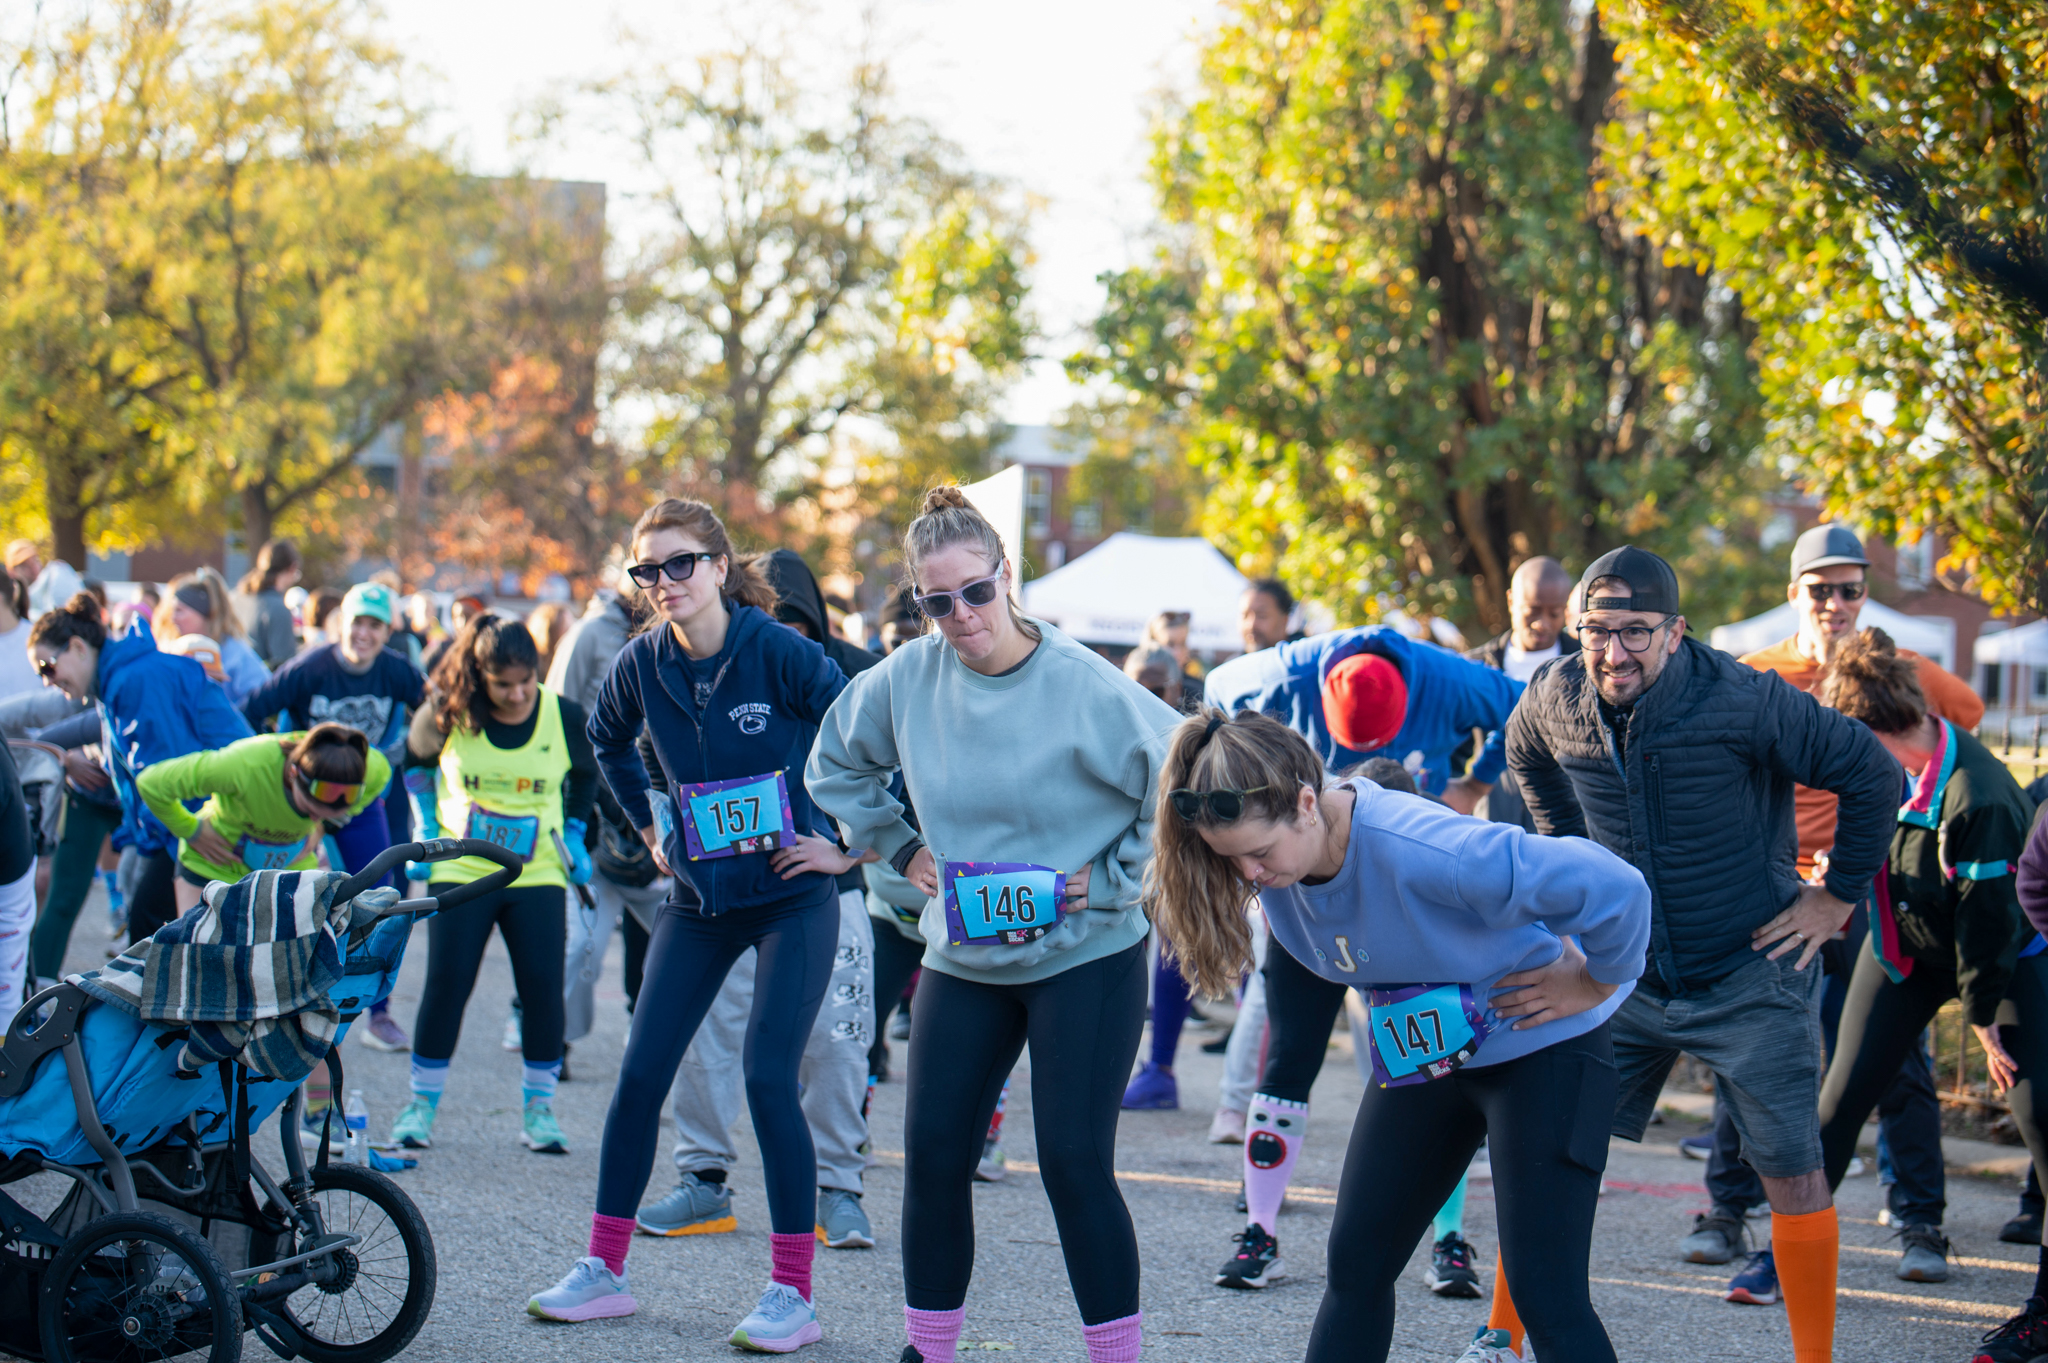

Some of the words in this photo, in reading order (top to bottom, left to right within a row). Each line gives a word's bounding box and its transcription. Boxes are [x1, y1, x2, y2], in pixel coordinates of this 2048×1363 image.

[728, 703, 750, 721] PENN
[749, 703, 771, 715] STATE
[708, 796, 760, 836] 157
[485, 823, 523, 850] 187
[975, 885, 1036, 924] 146
[1334, 935, 1357, 973] J
[1383, 1008, 1446, 1059] 147
[1437, 1057, 1453, 1069] 5K
